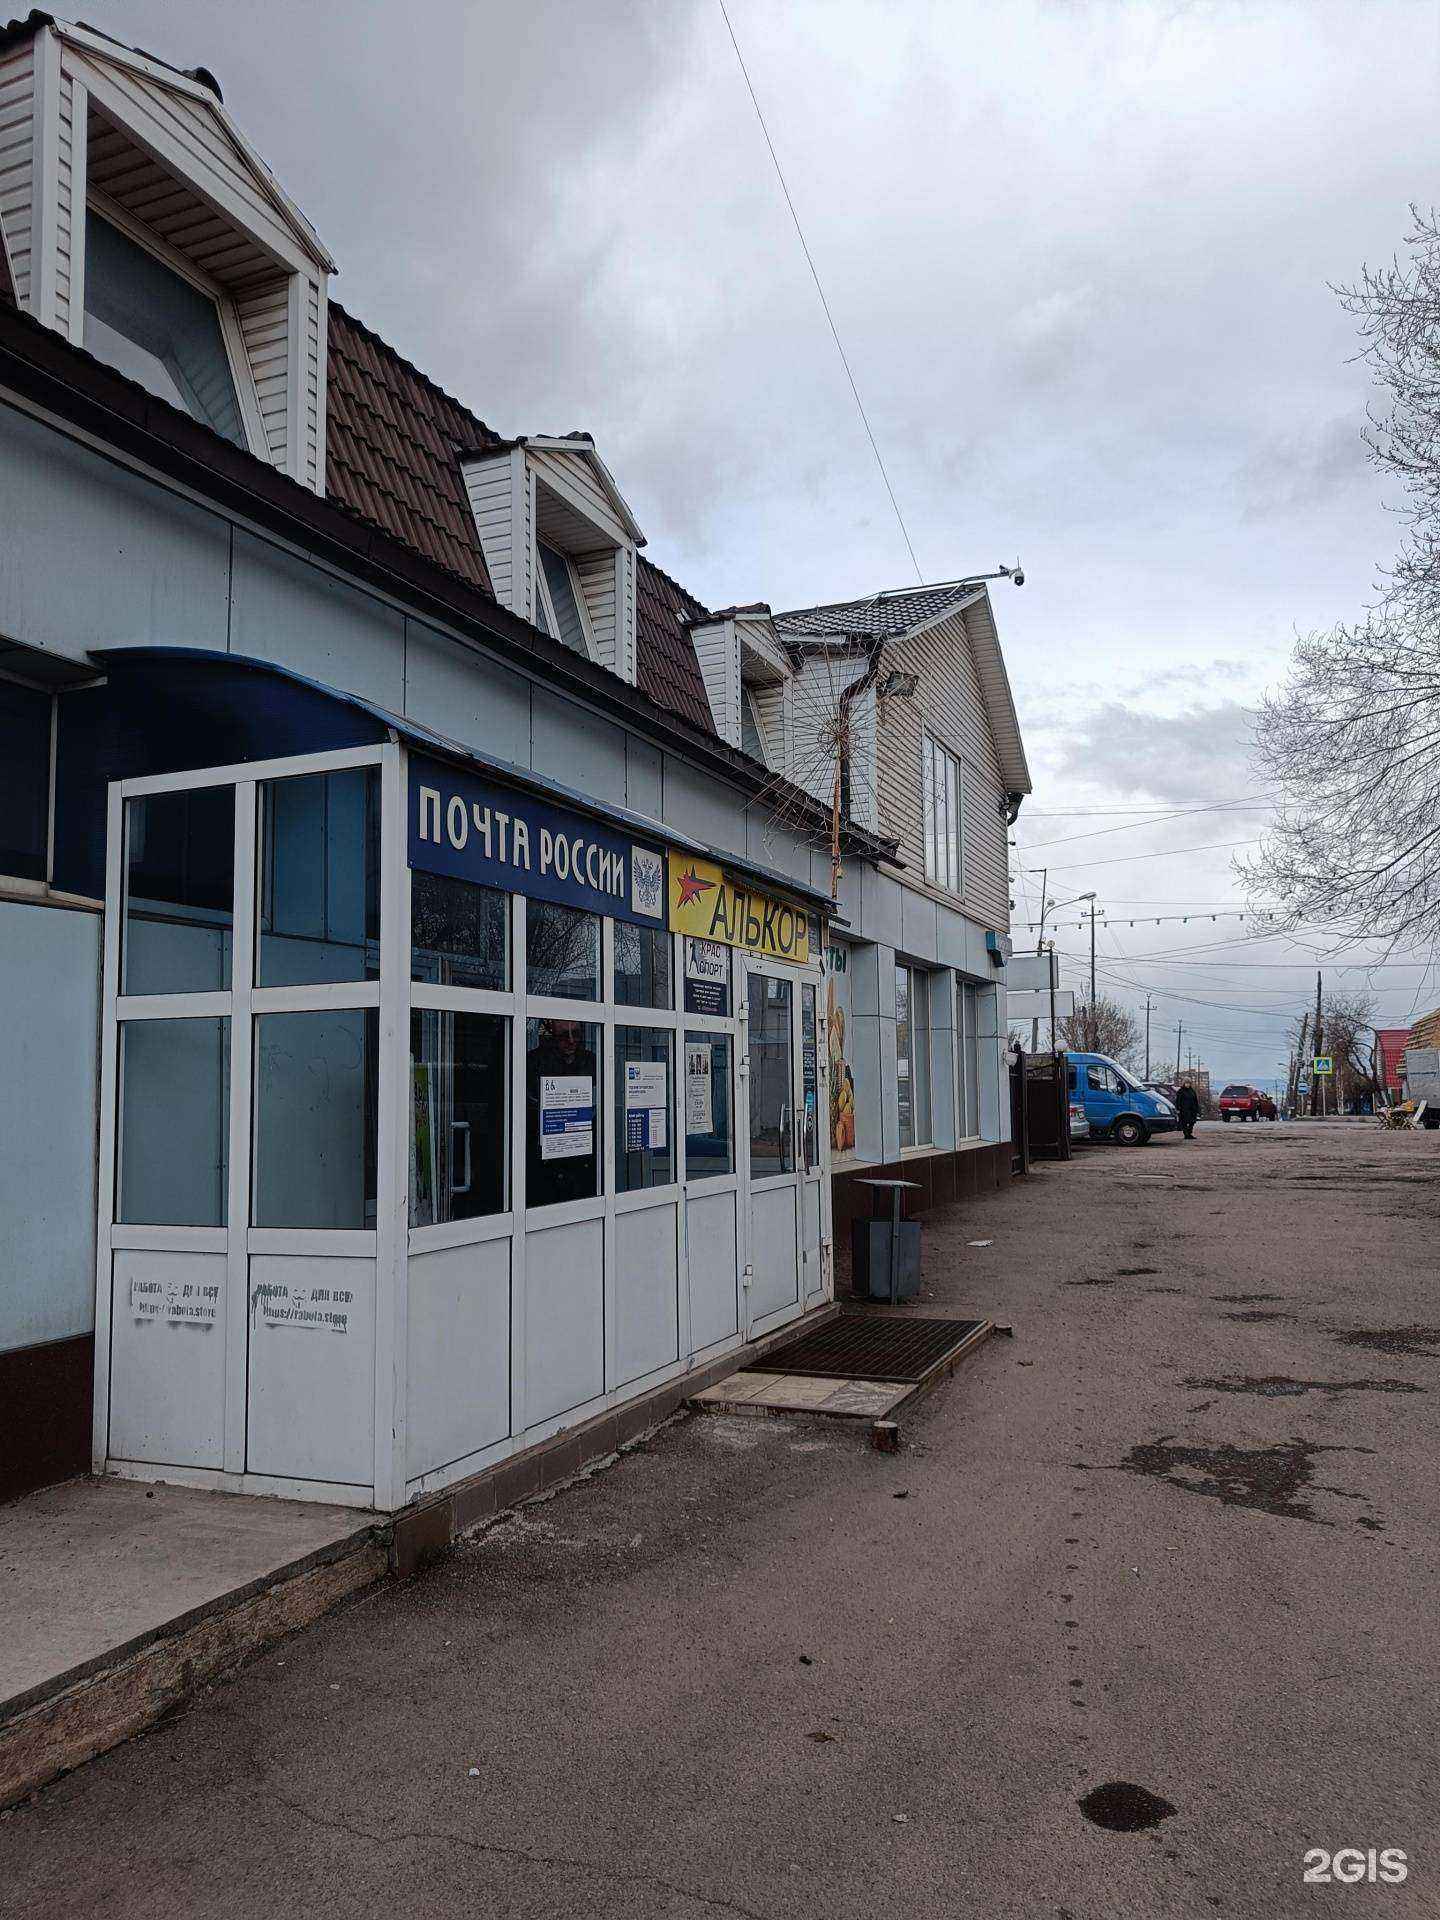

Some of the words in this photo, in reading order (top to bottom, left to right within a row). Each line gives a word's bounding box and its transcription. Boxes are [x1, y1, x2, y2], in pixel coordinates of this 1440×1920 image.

[419, 785, 531, 871] ПОЧТА
[540, 827, 625, 898] РОССИИ
[708, 884, 808, 957] АЛЬКОР
[699, 961, 723, 977] СПОРТ
